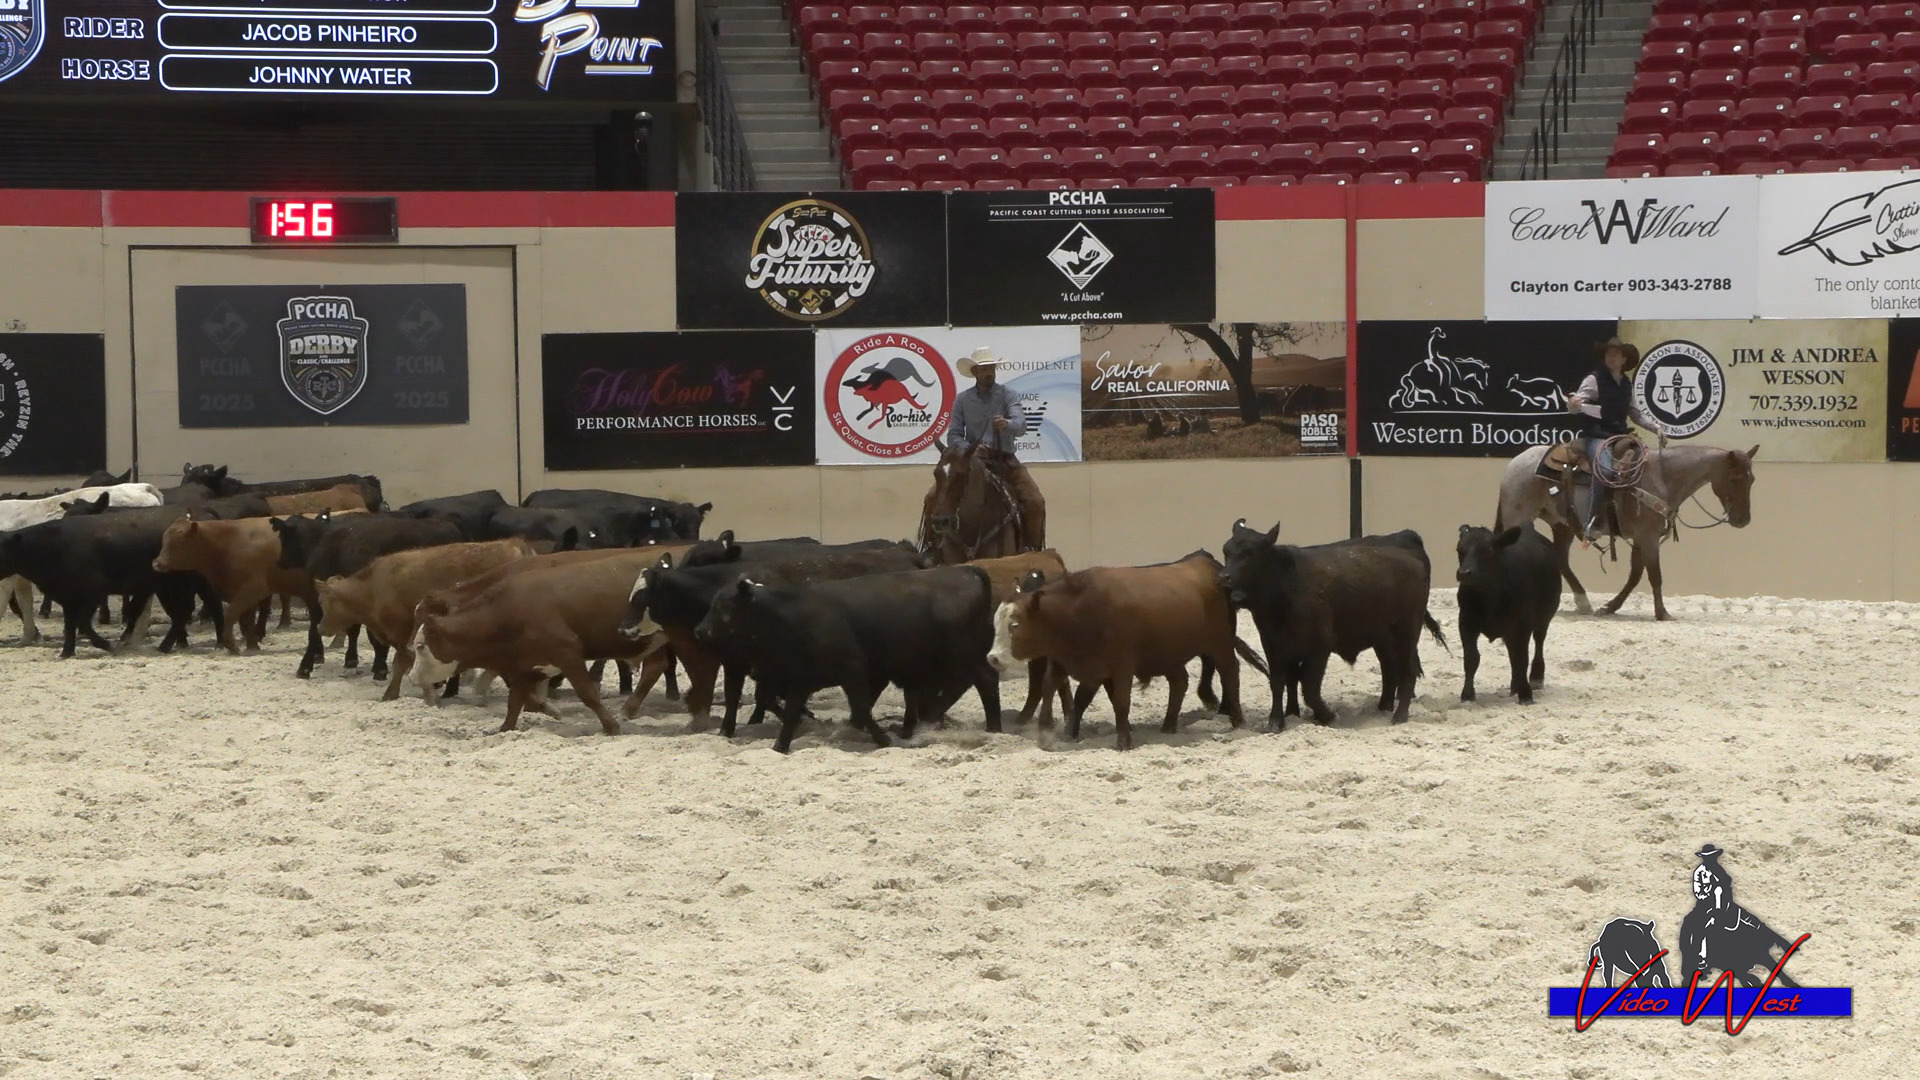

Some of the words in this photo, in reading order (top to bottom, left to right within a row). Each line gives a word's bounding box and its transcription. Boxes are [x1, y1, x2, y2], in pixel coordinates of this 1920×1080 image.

[0, 14, 23, 22] LLENGE
[64, 16, 144, 39] RIDER
[242, 24, 312, 42] JACOB
[318, 25, 417, 43] PINHEIRO
[61, 58, 150, 80] HORSE
[249, 66, 334, 84] JOHNNY
[340, 67, 412, 85] WATER
[1049, 191, 1107, 205] PCCHA
[271, 203, 333, 236] 1:56
[1113, 207, 1166, 215] ASSOCIATION
[1876, 202, 1920, 235] Cutti
[1509, 206, 1605, 241] Carol
[1637, 203, 1730, 239] Ward
[767, 218, 861, 260] Super
[745, 253, 875, 297] Futurity
[1510, 280, 1569, 295] Clayton
[1574, 279, 1624, 292] Carter
[1628, 278, 1732, 292] 903-343-2788
[1815, 277, 1842, 291] The
[1846, 277, 1879, 293] only
[1070, 293, 1081, 301] Cut
[294, 302, 349, 320] PCCHA
[1042, 311, 1123, 321] www.pccha.com
[289, 334, 357, 355] DERBY
[853, 337, 881, 354] Ride
[886, 335, 895, 344] A
[901, 337, 925, 354] Roo
[200, 357, 250, 376] PCCHA
[395, 355, 446, 374] PCCHA
[1728, 348, 1764, 367] JIM
[1770, 348, 1785, 364] &
[1792, 348, 1879, 364] ANDREA
[1091, 351, 1162, 391] Savor
[1639, 346, 1671, 377] WESSON
[1684, 347, 1720, 396] ASSOCIATES
[1762, 369, 1846, 385] WESSON
[1107, 380, 1143, 393] REAL
[1146, 379, 1230, 392] CALIFORNIA
[15, 380, 31, 430] REYZIN
[200, 394, 255, 411] 2025
[394, 390, 449, 409] 2025
[1749, 395, 1858, 412] 707.339.1932
[576, 415, 695, 430] PERFORMANCE
[699, 413, 757, 428] HORSES
[886, 406, 933, 428] Roo-hide
[1300, 413, 1338, 427] PASO
[1740, 417, 1866, 430] www.jdwesson.com
[832, 412, 843, 426] Sit
[866, 444, 892, 455] Close
[895, 447, 902, 455] &
[1301, 426, 1338, 436] ROBLES
[1372, 422, 1464, 445] Western
[1471, 423, 1583, 445] Bloodsto
[1014, 441, 1040, 451] ERICA
